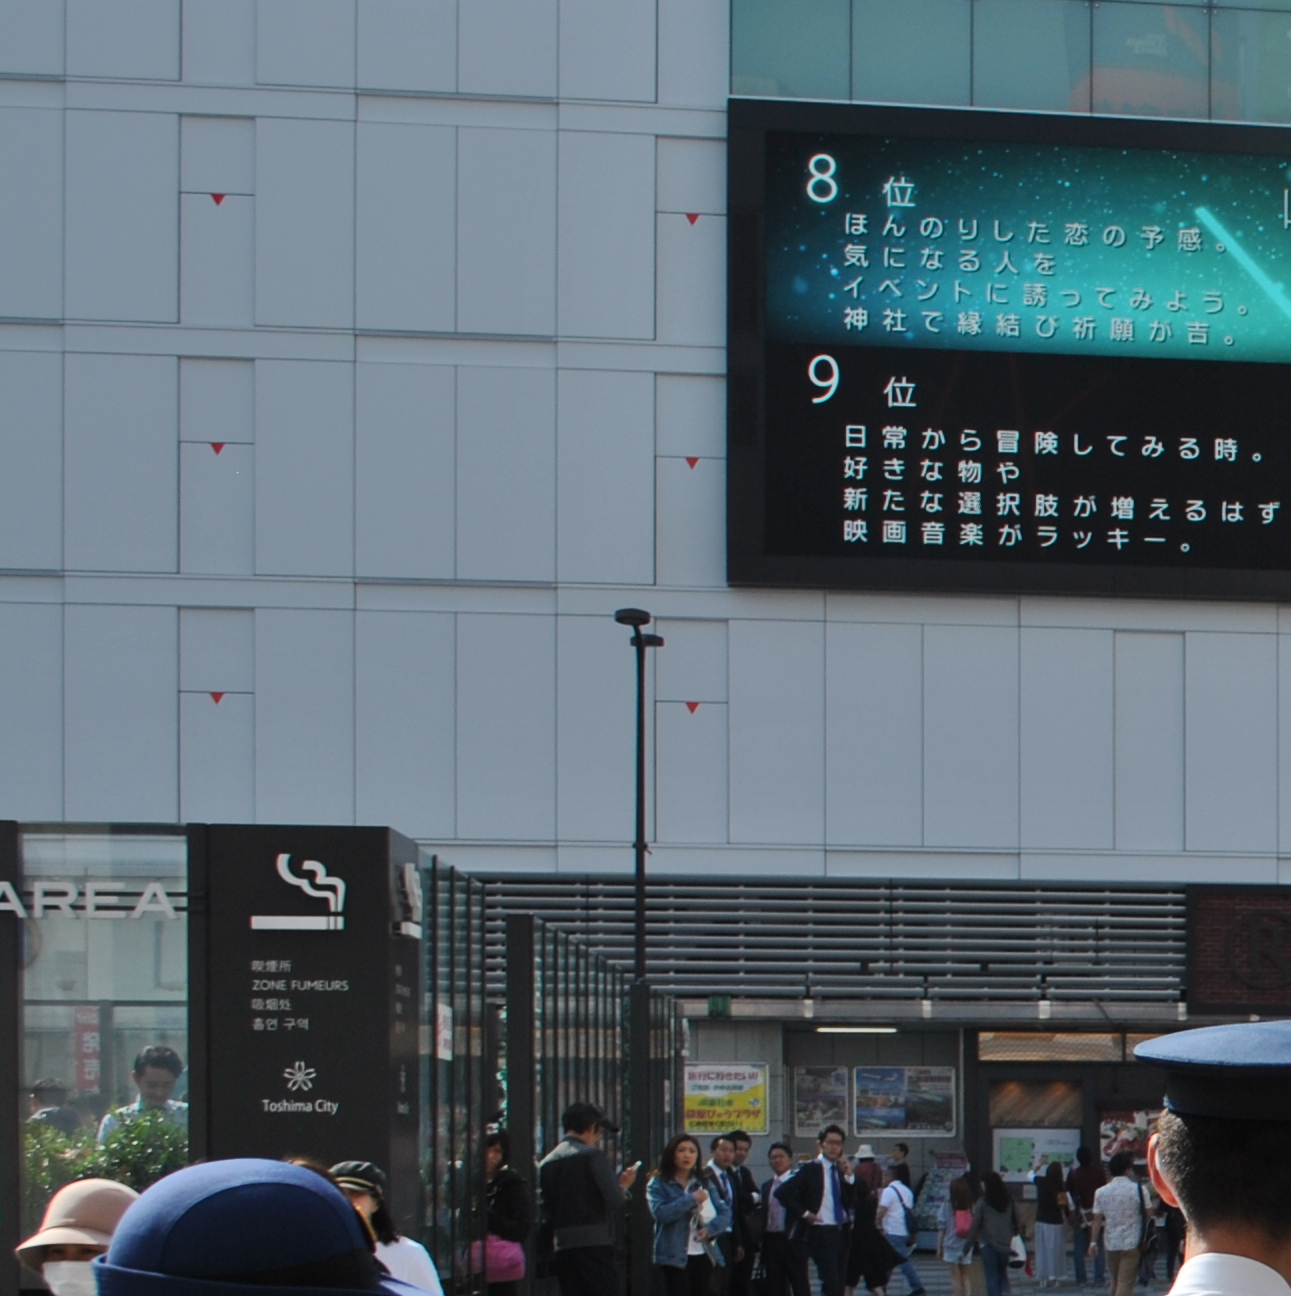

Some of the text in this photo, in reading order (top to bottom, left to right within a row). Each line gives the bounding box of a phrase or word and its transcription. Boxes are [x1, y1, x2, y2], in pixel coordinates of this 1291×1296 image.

[806, 153, 916, 208] 8 位
[844, 212, 1227, 252] ほんのりした恋の予感。
[844, 243, 1056, 275] 気になる人を
[843, 276, 1248, 316] イベントに誘ってみよう。
[807, 354, 917, 408] 9 位
[845, 425, 1262, 463] 日常から冒険してみる時。
[844, 457, 1020, 484] 好きな物や
[843, 519, 1191, 553] 映画音楽がラッキー。
[0, 881, 178, 919] AREA
[252, 979, 350, 992] ZONE FUMEURS
[262, 1099, 339, 1115] Toshima City
